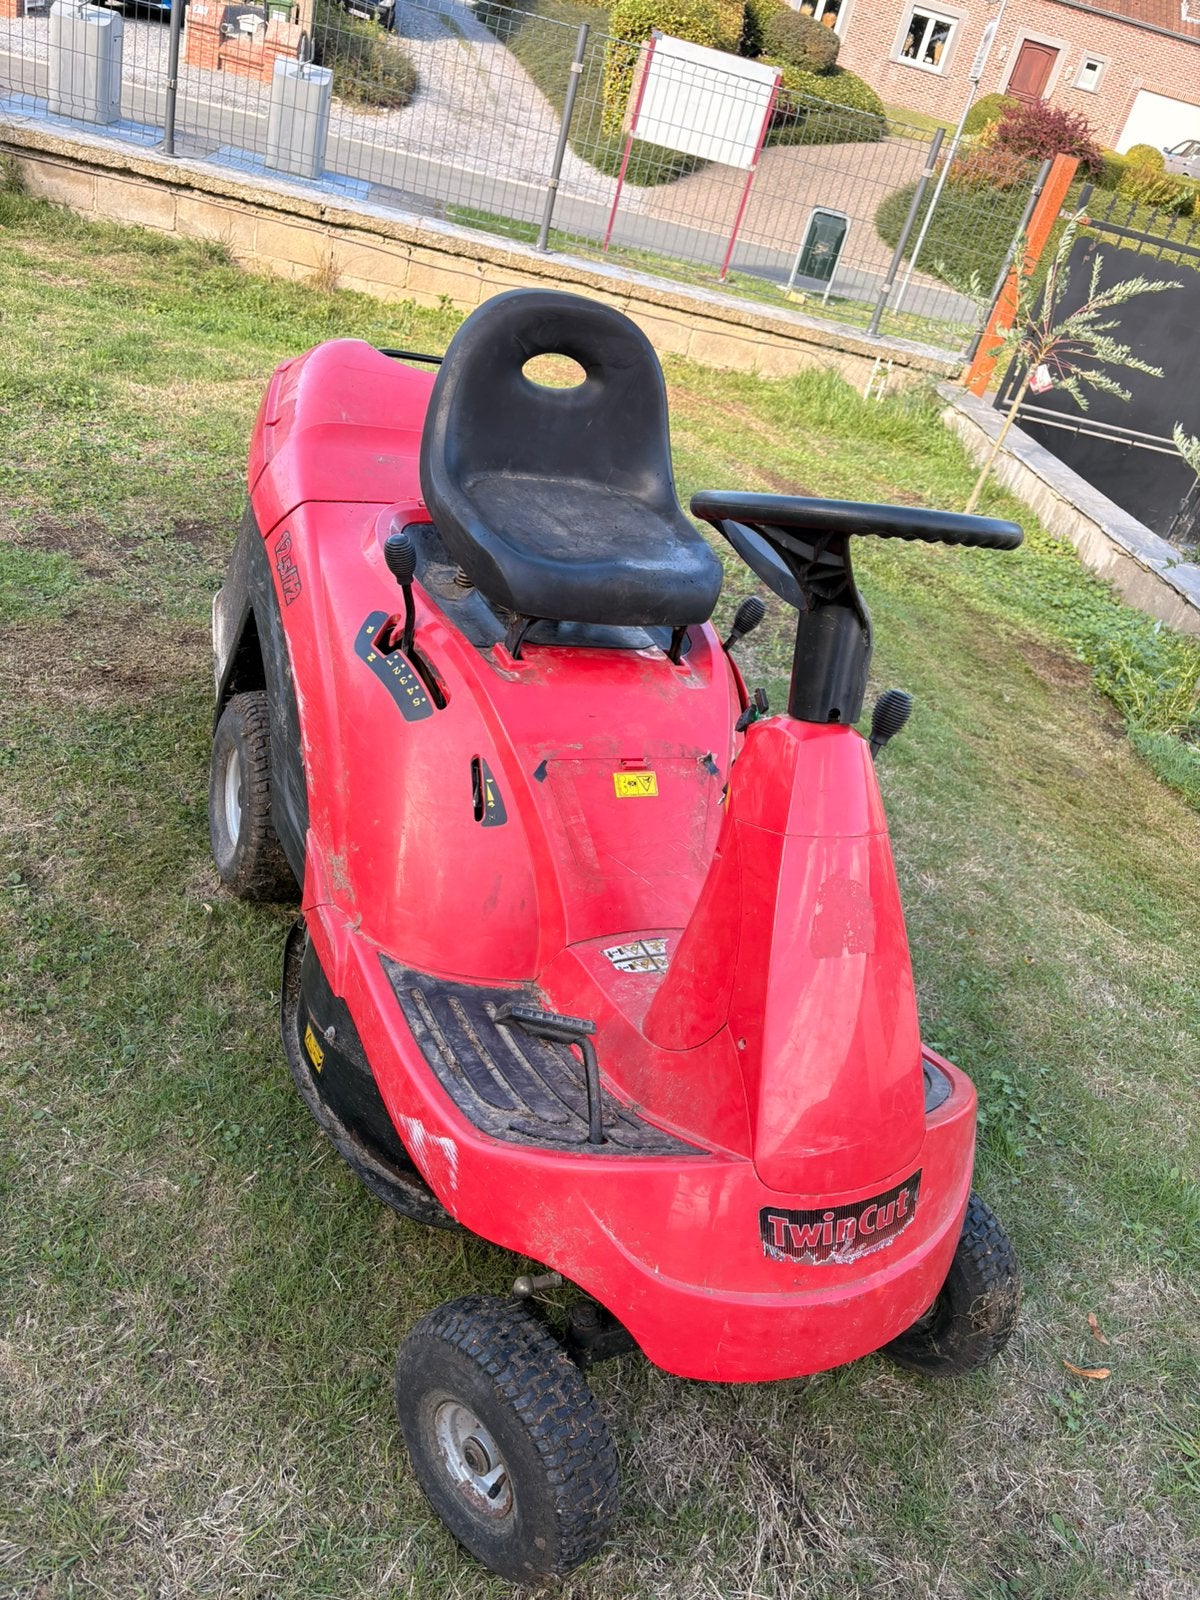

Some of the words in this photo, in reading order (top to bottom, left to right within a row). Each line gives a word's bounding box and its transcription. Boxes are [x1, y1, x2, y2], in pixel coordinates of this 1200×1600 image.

[392, 667, 401, 675] 2
[399, 676, 408, 685] 3
[406, 687, 414, 695] 4
[412, 698, 421, 706] 5
